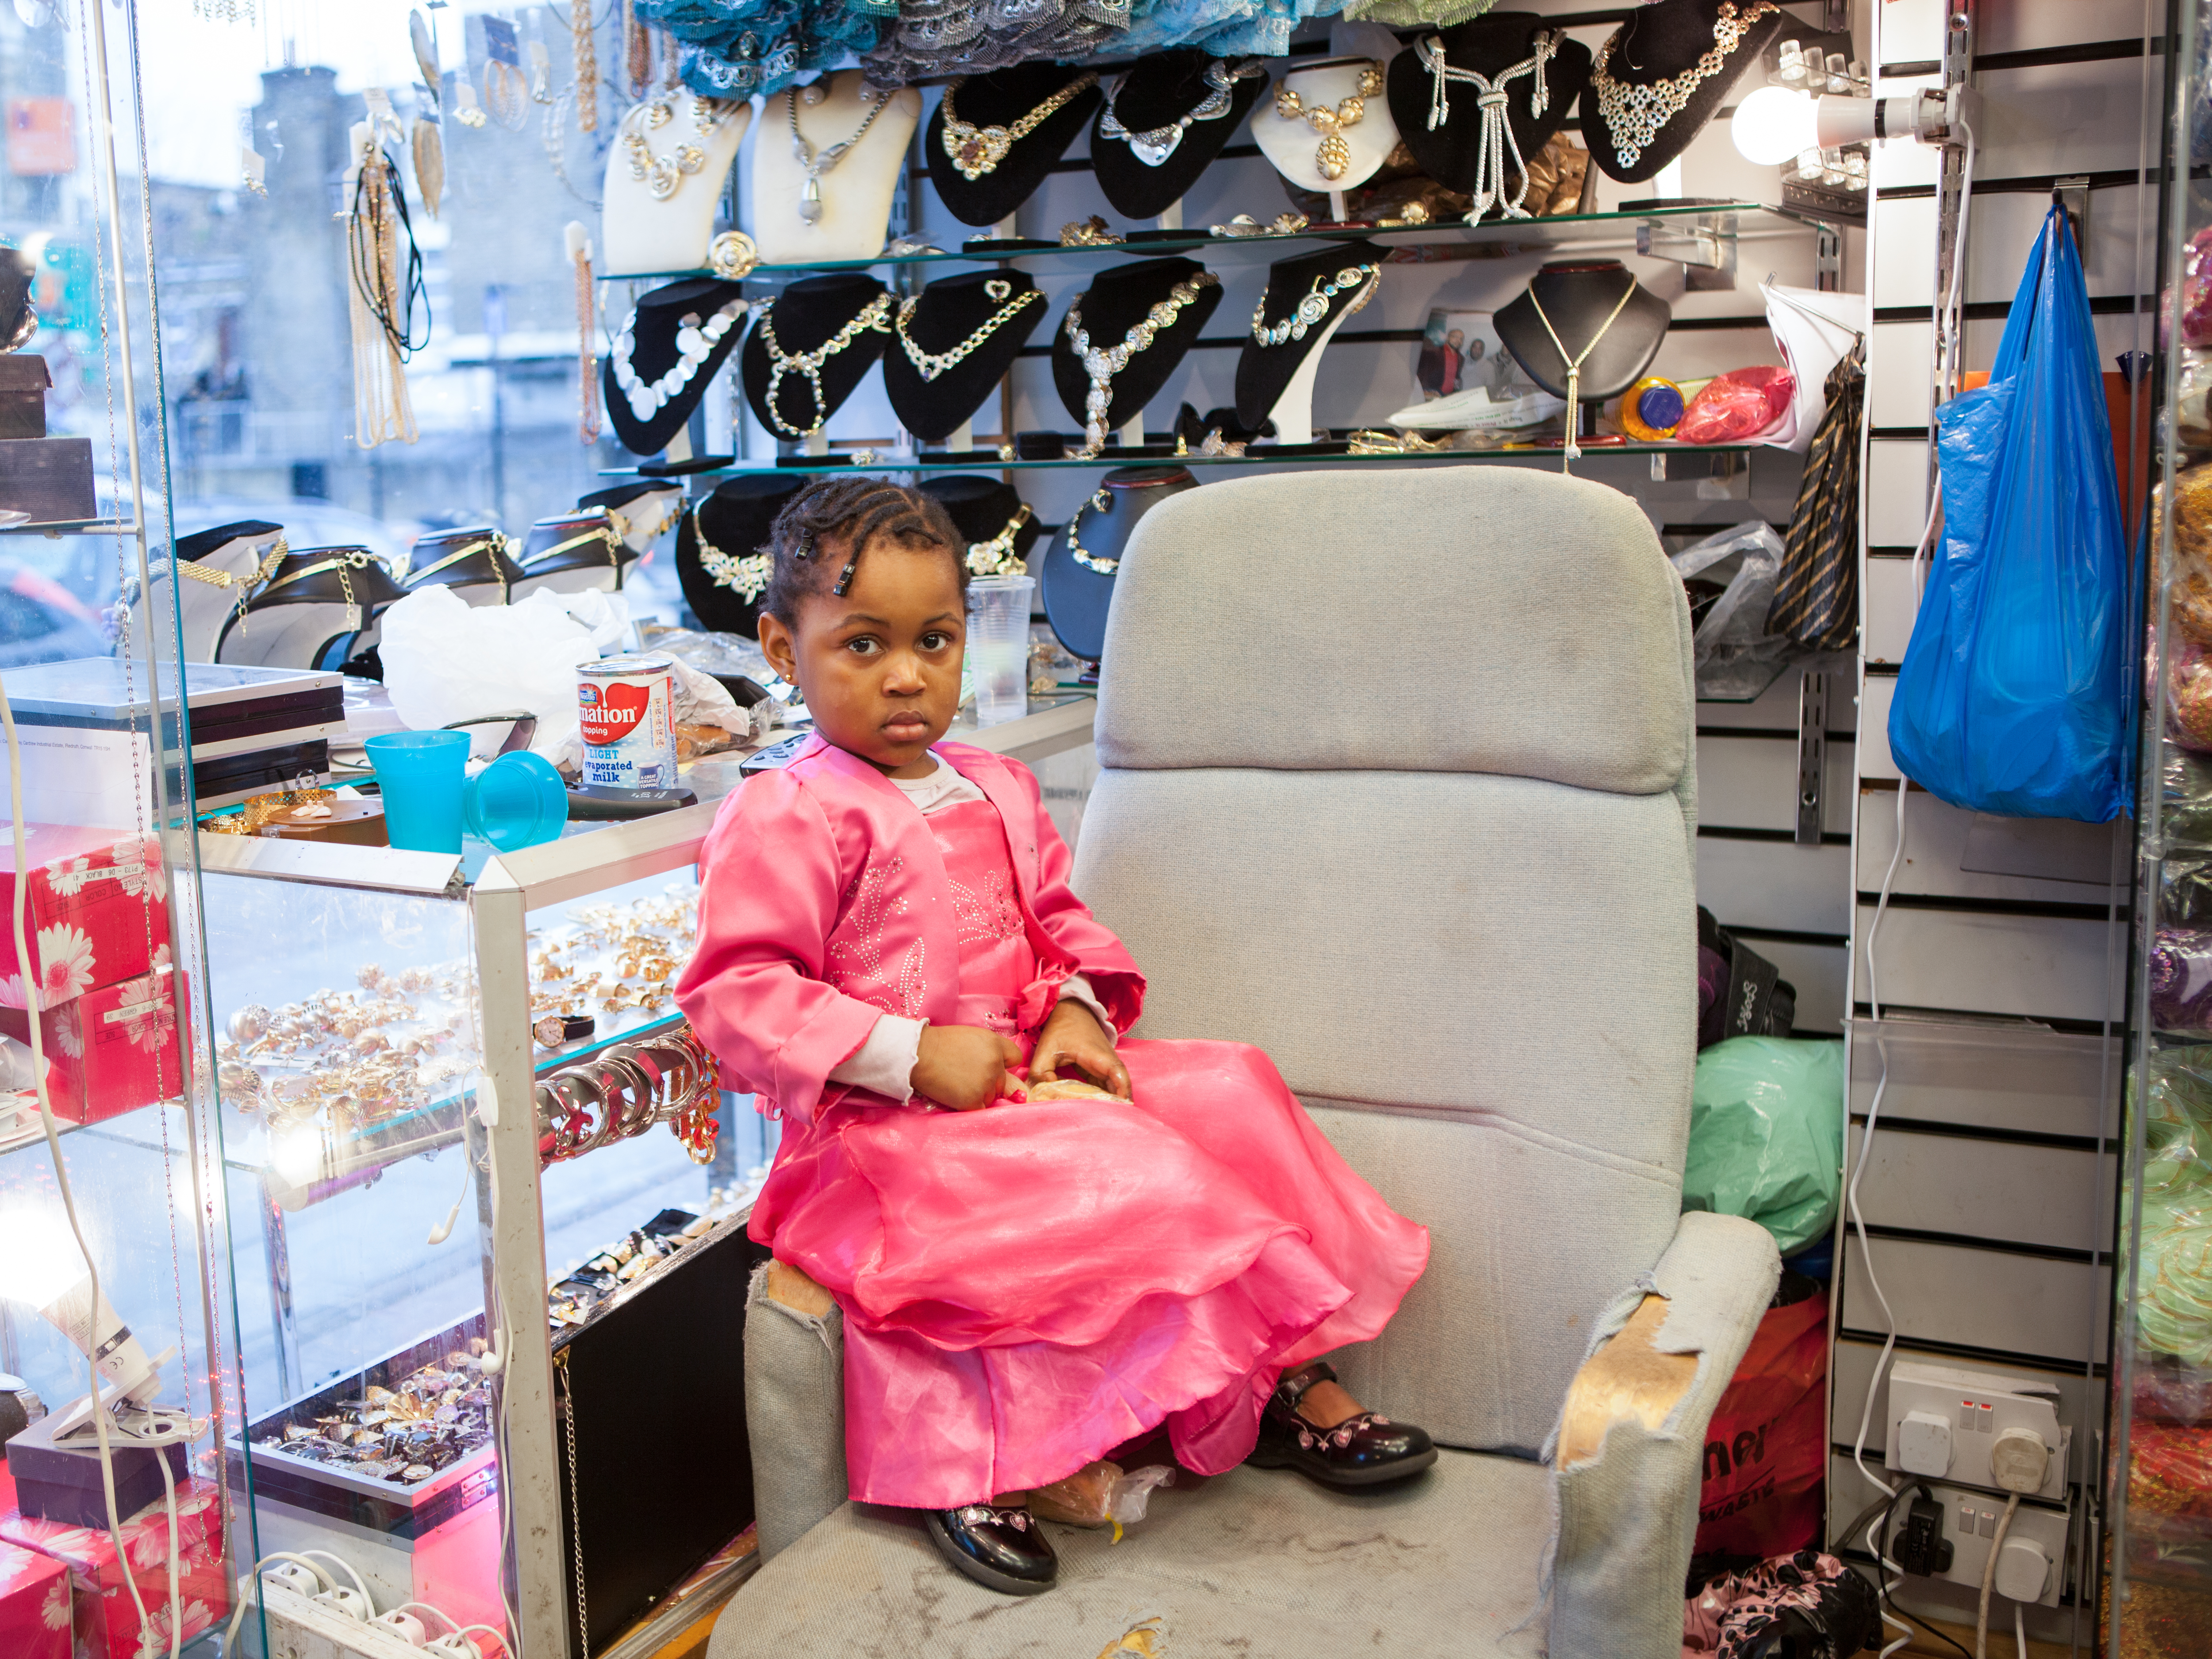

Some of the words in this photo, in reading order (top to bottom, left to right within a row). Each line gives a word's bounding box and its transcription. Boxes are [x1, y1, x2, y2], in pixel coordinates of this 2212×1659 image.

[583, 726, 608, 736] topping
[590, 749, 619, 759] LIGHT
[585, 761, 633, 772] evaporated
[593, 772, 619, 782] milk
[86, 871, 102, 879] BLACK
[124, 876, 142, 888] STYLE
[86, 889, 106, 901] COLOR
[56, 901, 70, 911] SIZE
[119, 1007, 137, 1018] GREEN
[132, 1023, 146, 1032] COLOR
[190, 1588, 203, 1599] SIZE
[154, 1606, 171, 1621] COLO
